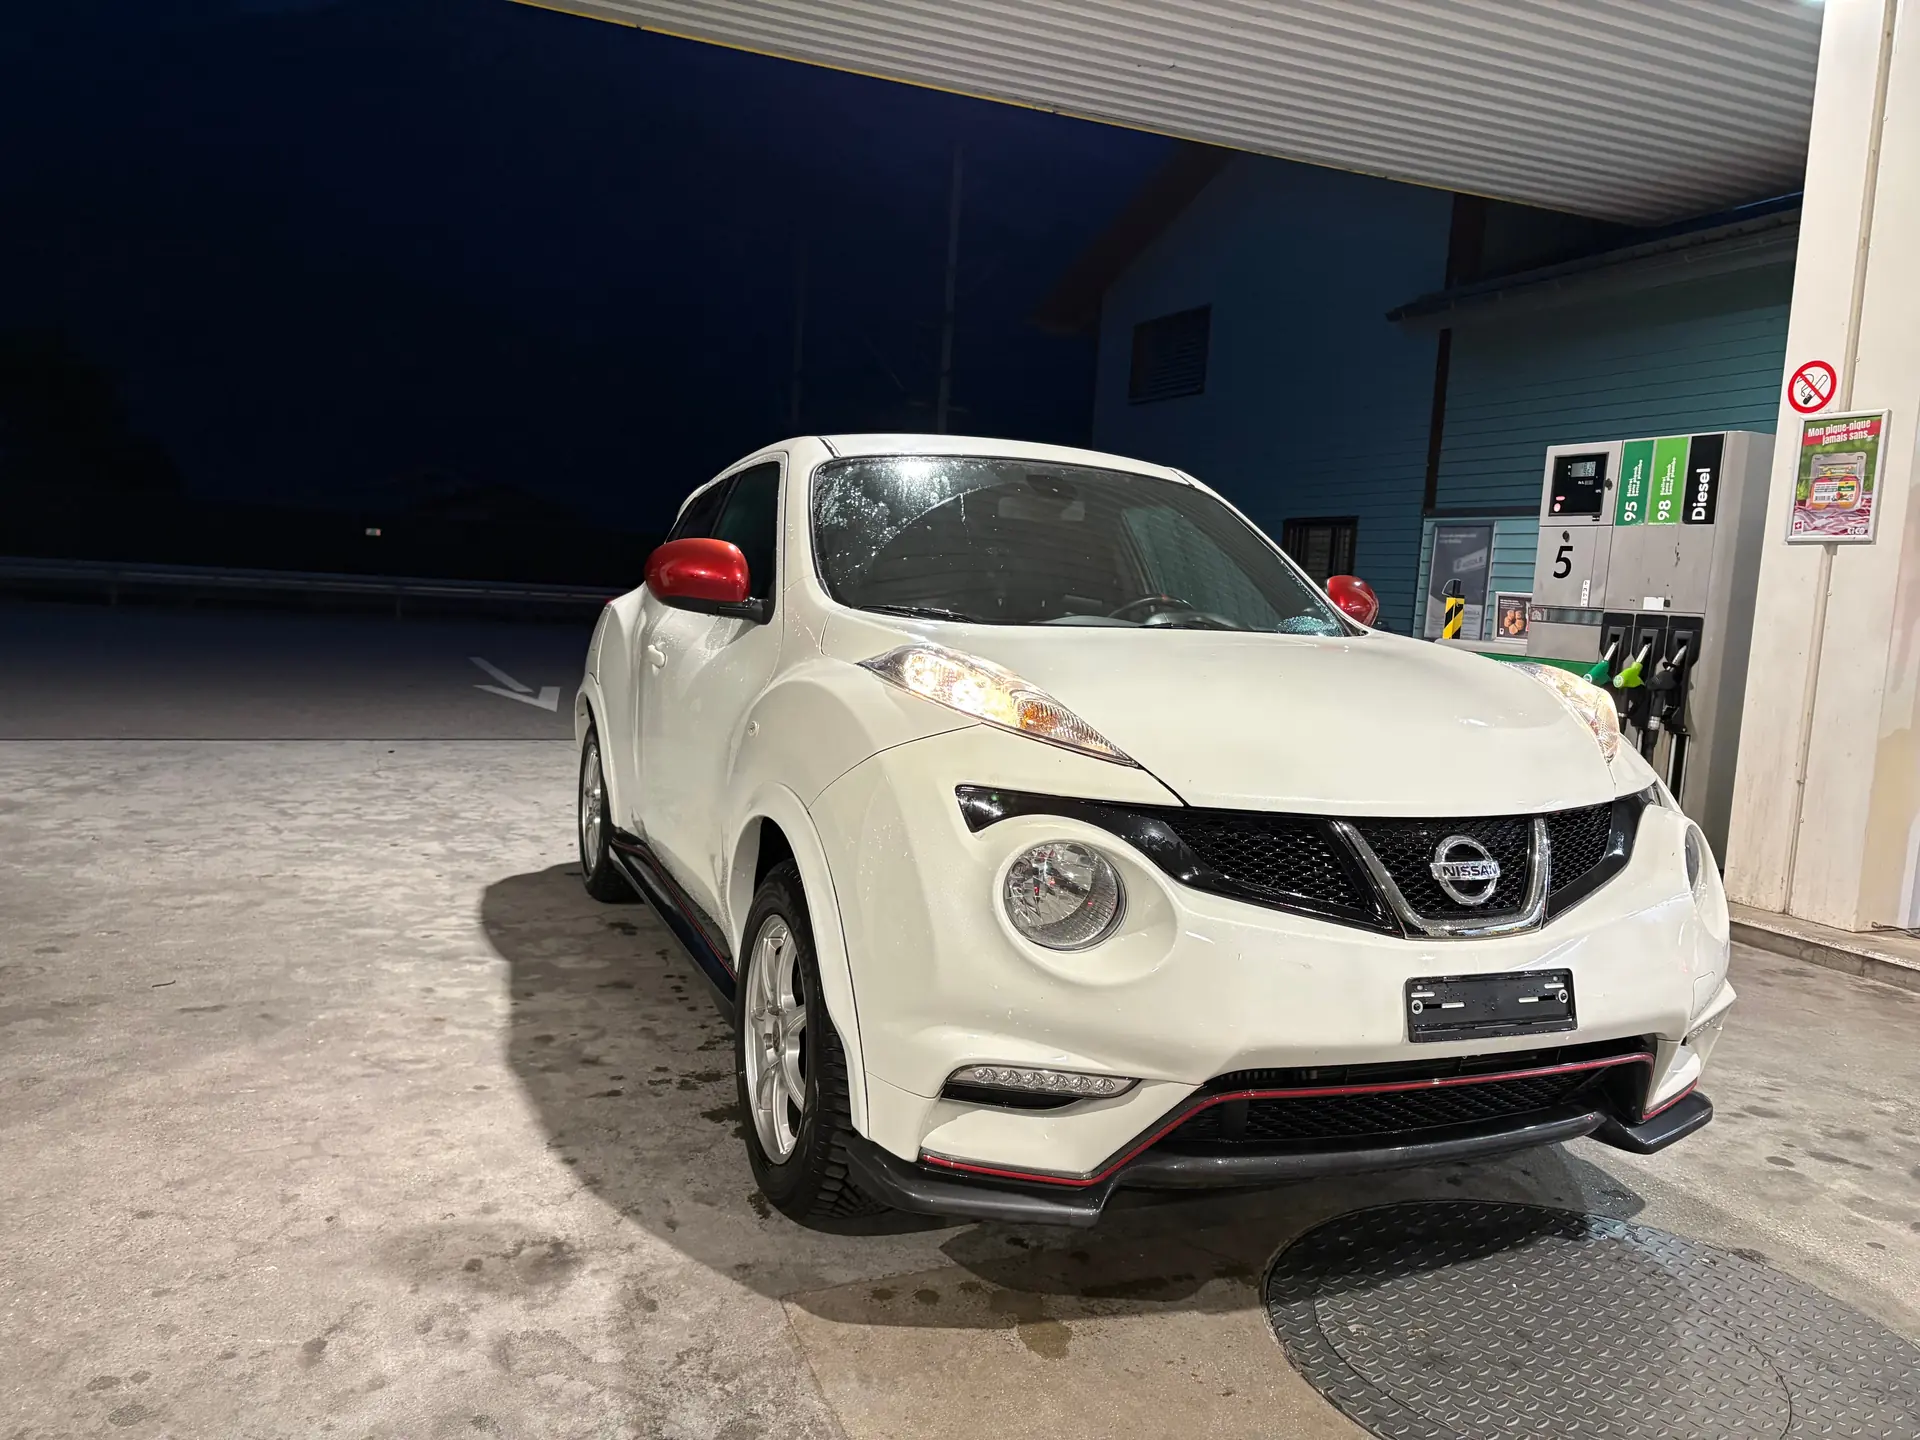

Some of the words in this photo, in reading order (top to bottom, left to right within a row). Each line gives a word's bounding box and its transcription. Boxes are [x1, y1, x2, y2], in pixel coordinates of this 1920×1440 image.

[1808, 427, 1824, 437] Mon
[1825, 419, 1871, 436] pique-nique
[1822, 432, 1848, 446] jamais
[1691, 467, 1711, 521] Diesel
[1624, 501, 1638, 522] 95
[1657, 499, 1671, 521] 98
[1553, 545, 1574, 579] 5
[1442, 865, 1497, 877] NISSAN
